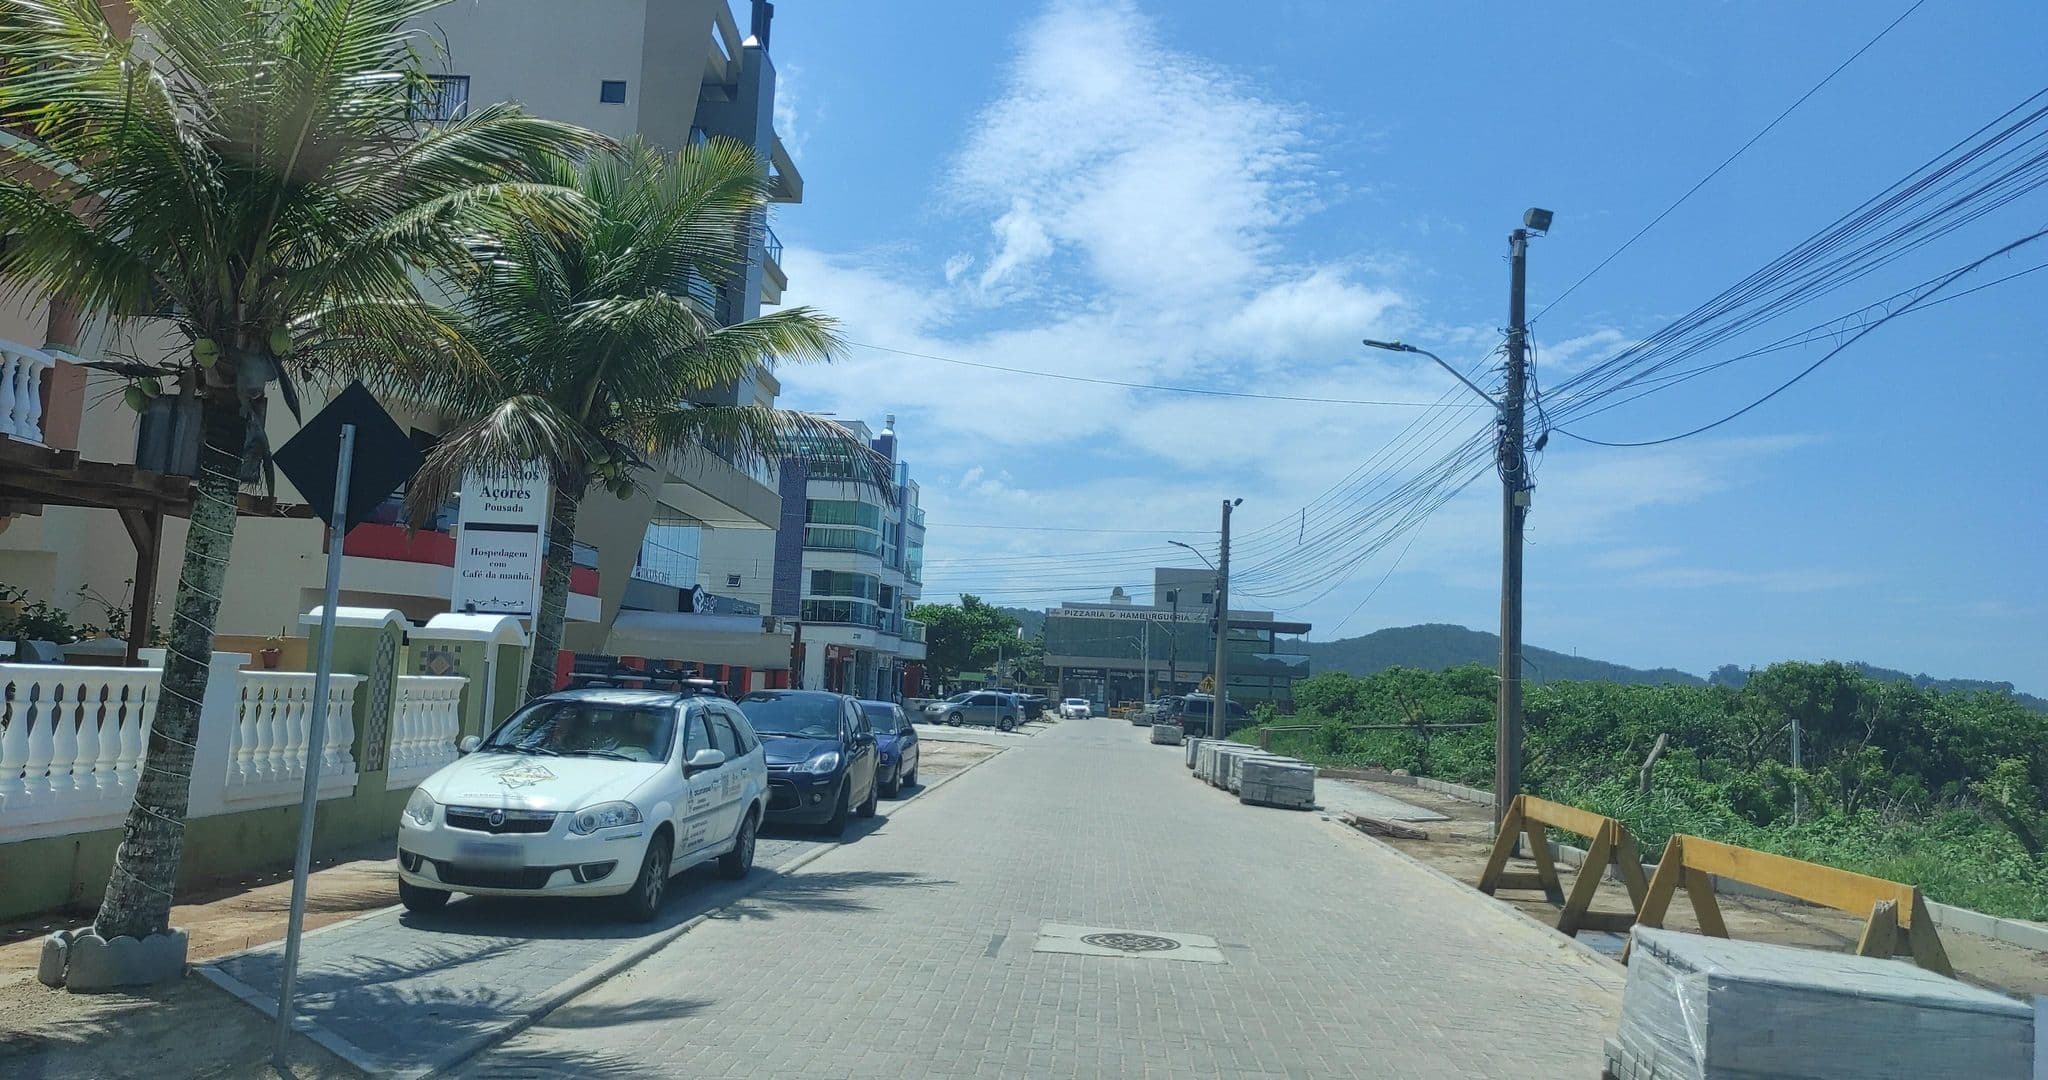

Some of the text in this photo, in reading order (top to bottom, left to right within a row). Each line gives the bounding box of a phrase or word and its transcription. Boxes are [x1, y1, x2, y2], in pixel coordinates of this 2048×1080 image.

[480, 485, 531, 501] Açores
[485, 503, 523, 513] Pousada
[470, 547, 528, 559] Hospedagem
[463, 568, 483, 579] Café
[485, 570, 497, 579] da
[1064, 609, 1105, 618] PIZZARIA
